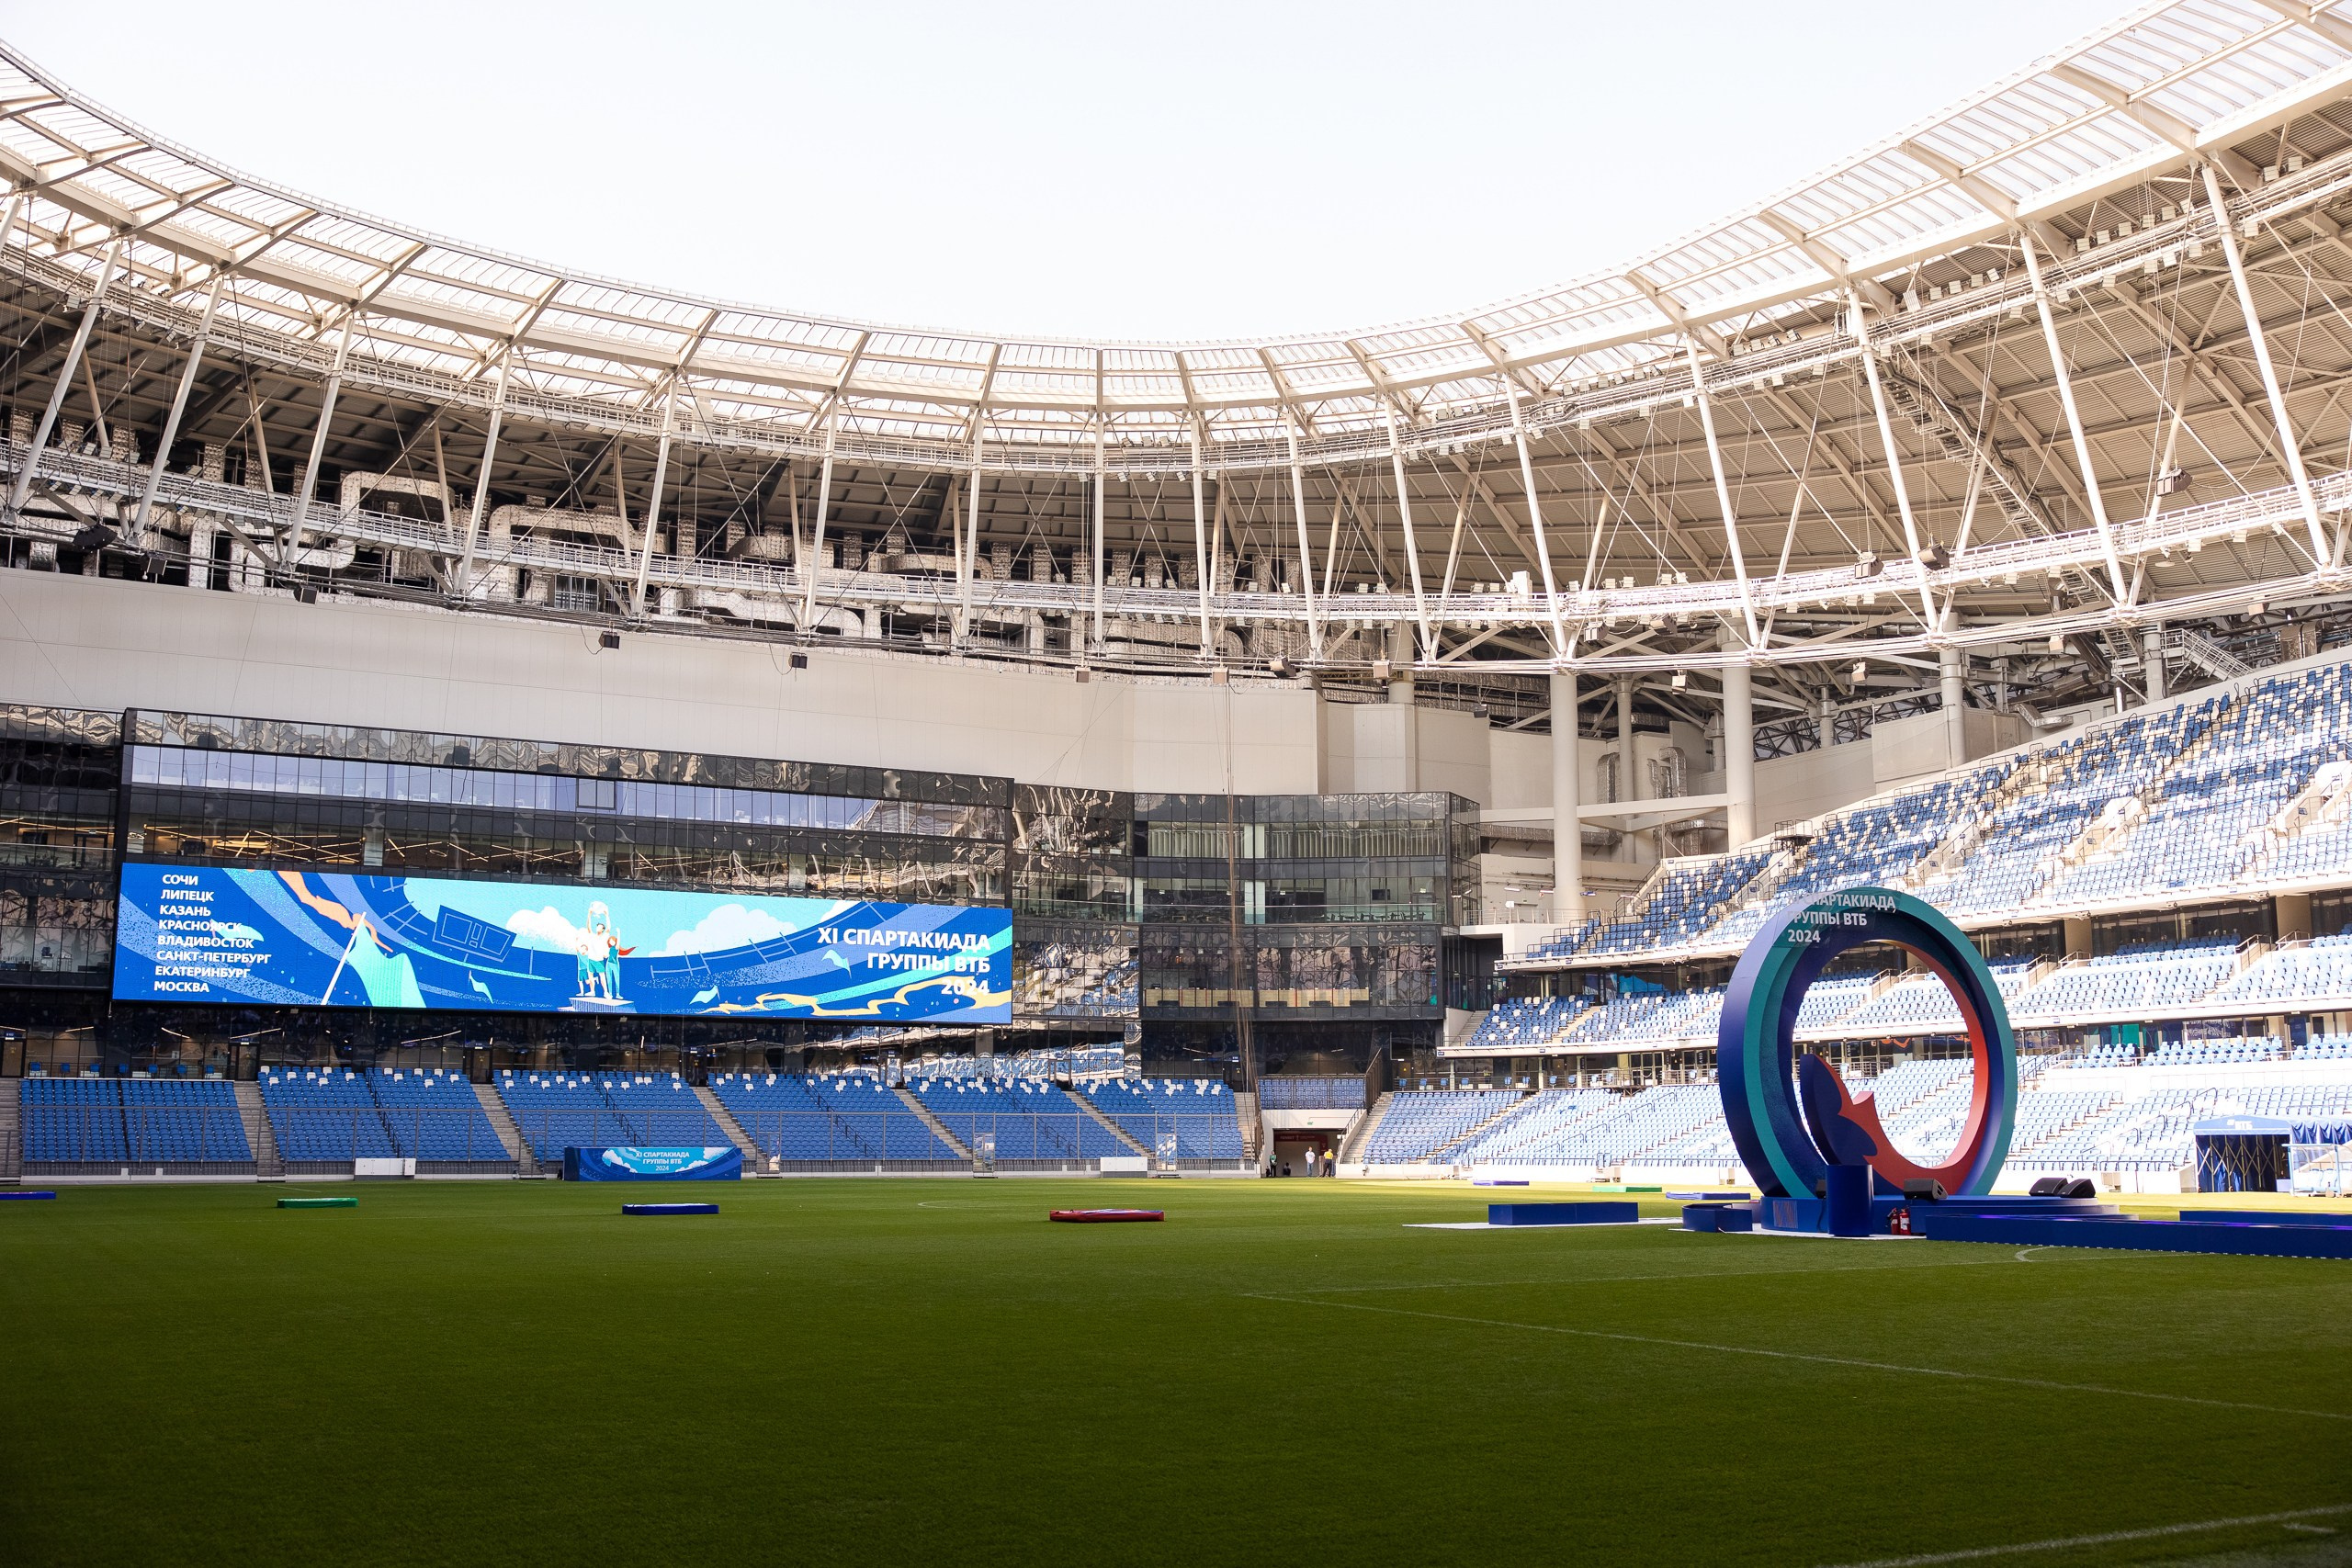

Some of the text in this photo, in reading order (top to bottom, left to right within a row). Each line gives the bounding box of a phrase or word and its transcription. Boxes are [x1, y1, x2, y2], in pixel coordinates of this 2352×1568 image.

[162, 874, 199, 886] СОЧИ
[161, 889, 214, 902] ЛИПЕЦК
[160, 905, 211, 917] КАЗАНЬ
[159, 919, 242, 932] КРАСНОЯРСК
[1843, 913, 1868, 926] ВТБ
[157, 935, 254, 949] ВЛАДИВОСТОК
[817, 927, 991, 953] XI СПАРТАКИАДА
[1788, 929, 1821, 942] 2024
[156, 950, 272, 964] САНКТ-ПЕТЕРБУРГ
[867, 953, 991, 973] ГРУППЫ ВТБ
[155, 965, 251, 978] ЕКАТЕРИНБУРГ
[153, 981, 209, 993] МОСКВА
[941, 978, 990, 996] 2024
